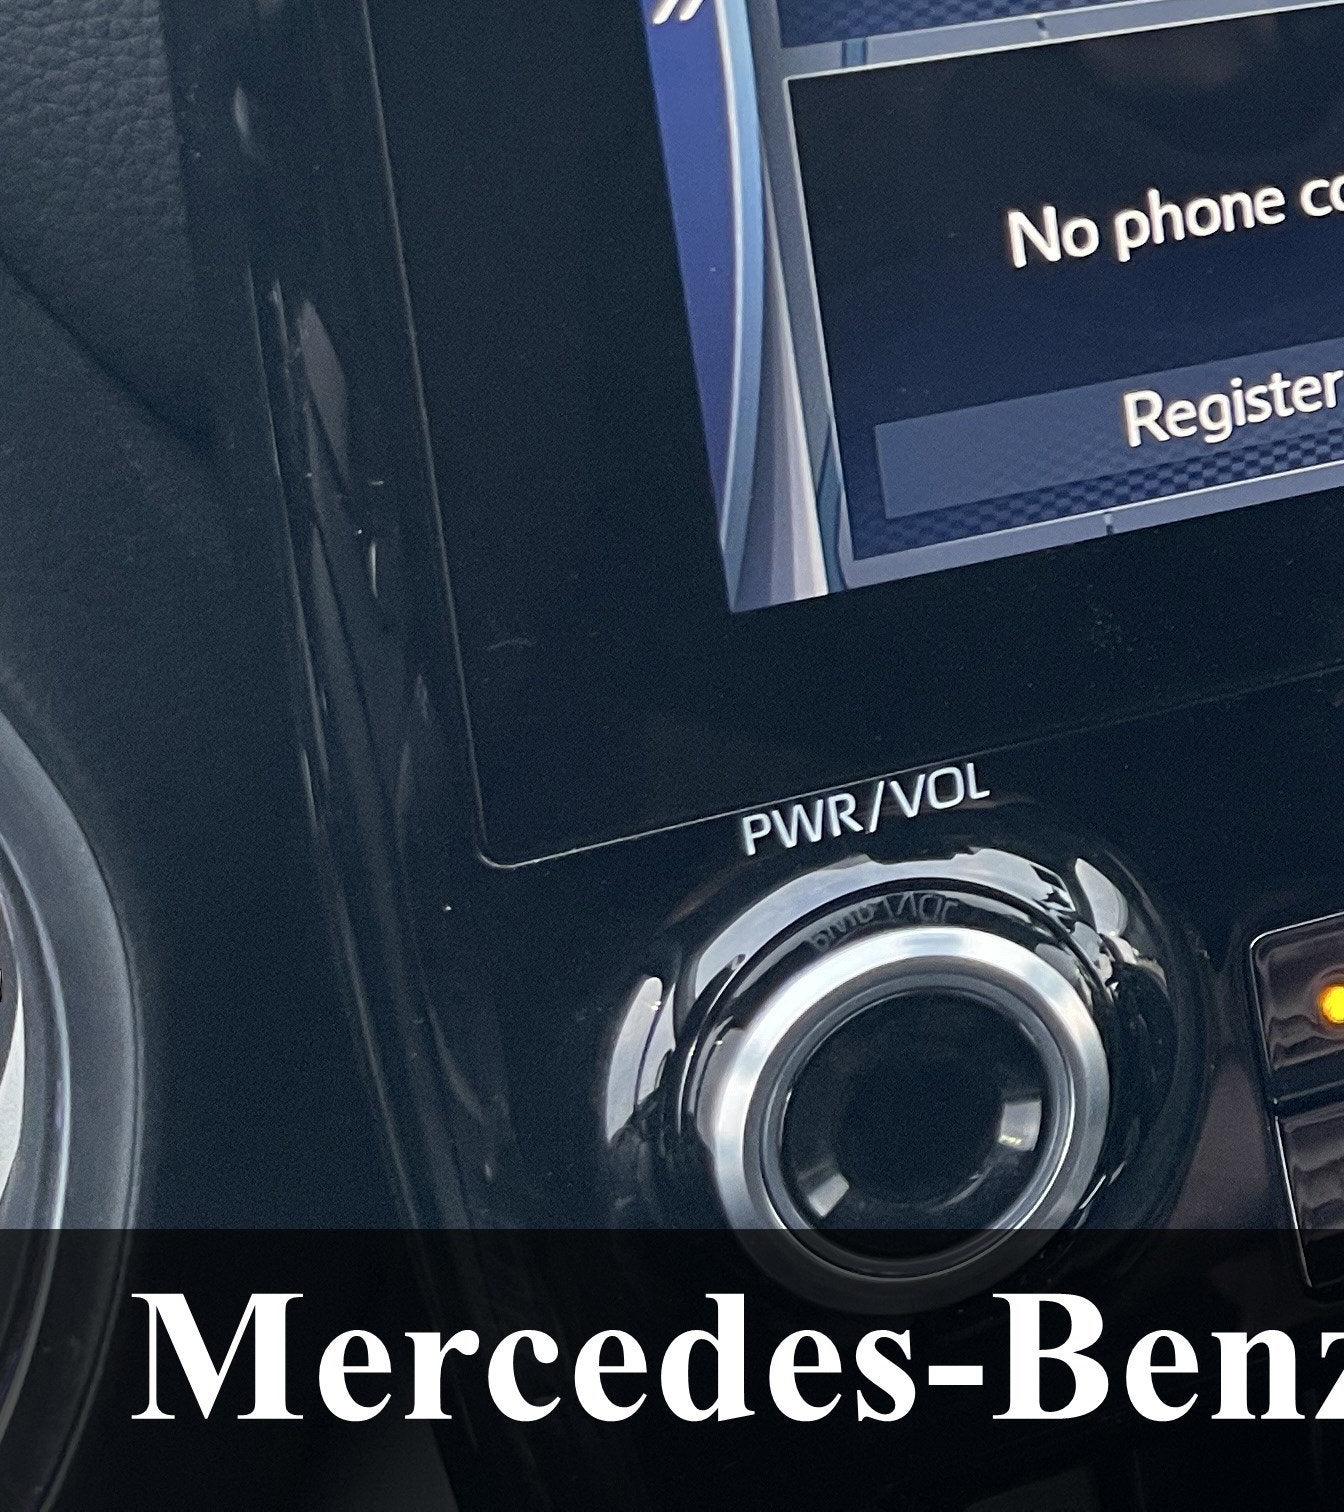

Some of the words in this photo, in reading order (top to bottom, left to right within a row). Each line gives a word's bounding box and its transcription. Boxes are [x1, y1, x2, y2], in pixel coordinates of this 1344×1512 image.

[1007, 205, 1101, 268] No
[1114, 187, 1287, 262] phone
[1123, 364, 1344, 447] Register
[740, 762, 992, 856] PWR/VOL
